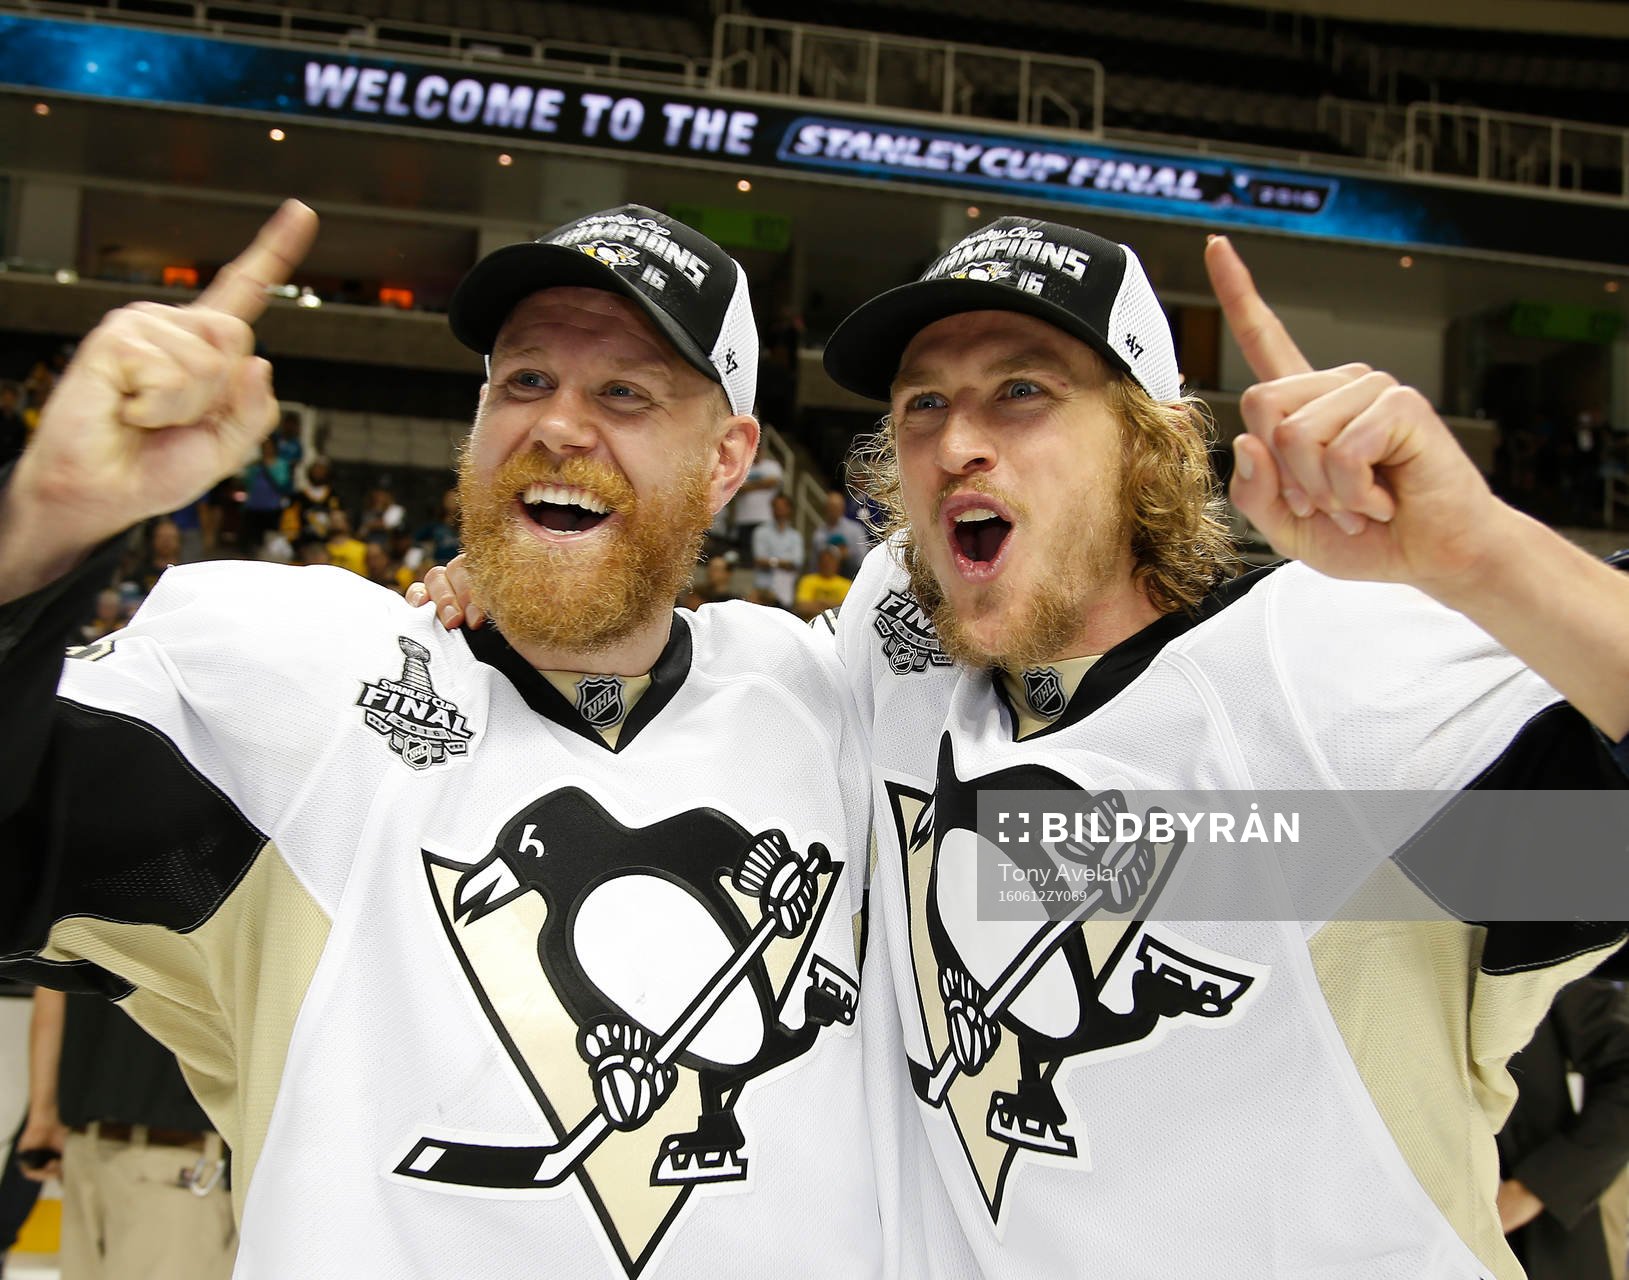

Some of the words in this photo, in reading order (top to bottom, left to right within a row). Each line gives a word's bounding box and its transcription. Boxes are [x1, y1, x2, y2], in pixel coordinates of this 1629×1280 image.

[304, 60, 565, 134] WELCOME
[580, 93, 645, 142] TO
[662, 103, 758, 157] THE
[794, 124, 981, 173] STANLEY
[978, 146, 1071, 183] CUP
[1067, 157, 1203, 200] FINAL
[637, 218, 672, 236] Cup
[1006, 226, 1044, 240] Cup
[640, 263, 669, 292] 16
[1016, 270, 1046, 296] 16
[879, 593, 936, 634] FIN
[379, 679, 434, 703] STANLEY
[431, 697, 457, 711] CUP
[587, 688, 617, 719] NHL
[1033, 680, 1055, 707] NHL
[361, 685, 474, 739] FINAL
[395, 716, 441, 737] 2016
